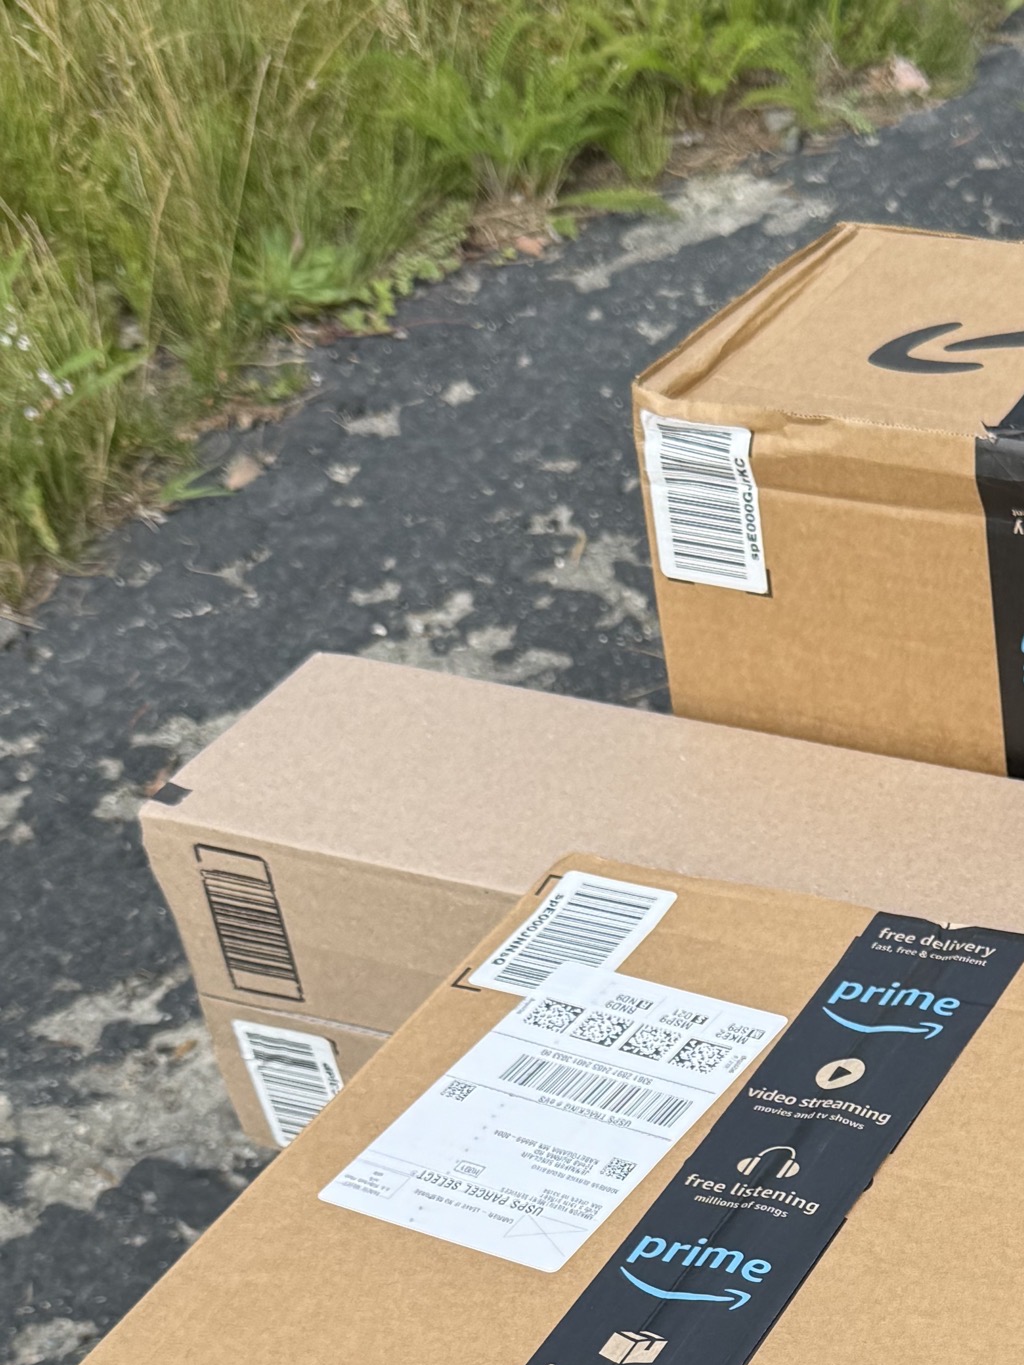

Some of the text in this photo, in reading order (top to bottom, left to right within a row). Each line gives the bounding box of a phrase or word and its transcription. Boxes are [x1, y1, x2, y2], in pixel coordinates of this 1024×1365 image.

[871, 942, 893, 954] fast,
[896, 946, 917, 956] free
[930, 954, 987, 967] convenient
[878, 927, 997, 958] free delivery
[603, 1001, 637, 1013] RND9
[828, 980, 960, 1016] prime
[658, 1015, 693, 1028] MSP9
[714, 1030, 749, 1043] MKE2
[563, 1103, 606, 1118] TRACKING
[748, 1087, 892, 1125] video streaming
[754, 1105, 792, 1117] movies
[829, 1115, 864, 1130] shows
[607, 1116, 632, 1125] USPS
[416, 1170, 545, 1215] USPS PARCEL SELECT
[685, 1174, 820, 1215] free listening
[694, 1194, 739, 1208] millions
[754, 1203, 788, 1218] songs
[626, 1232, 772, 1283] prime
